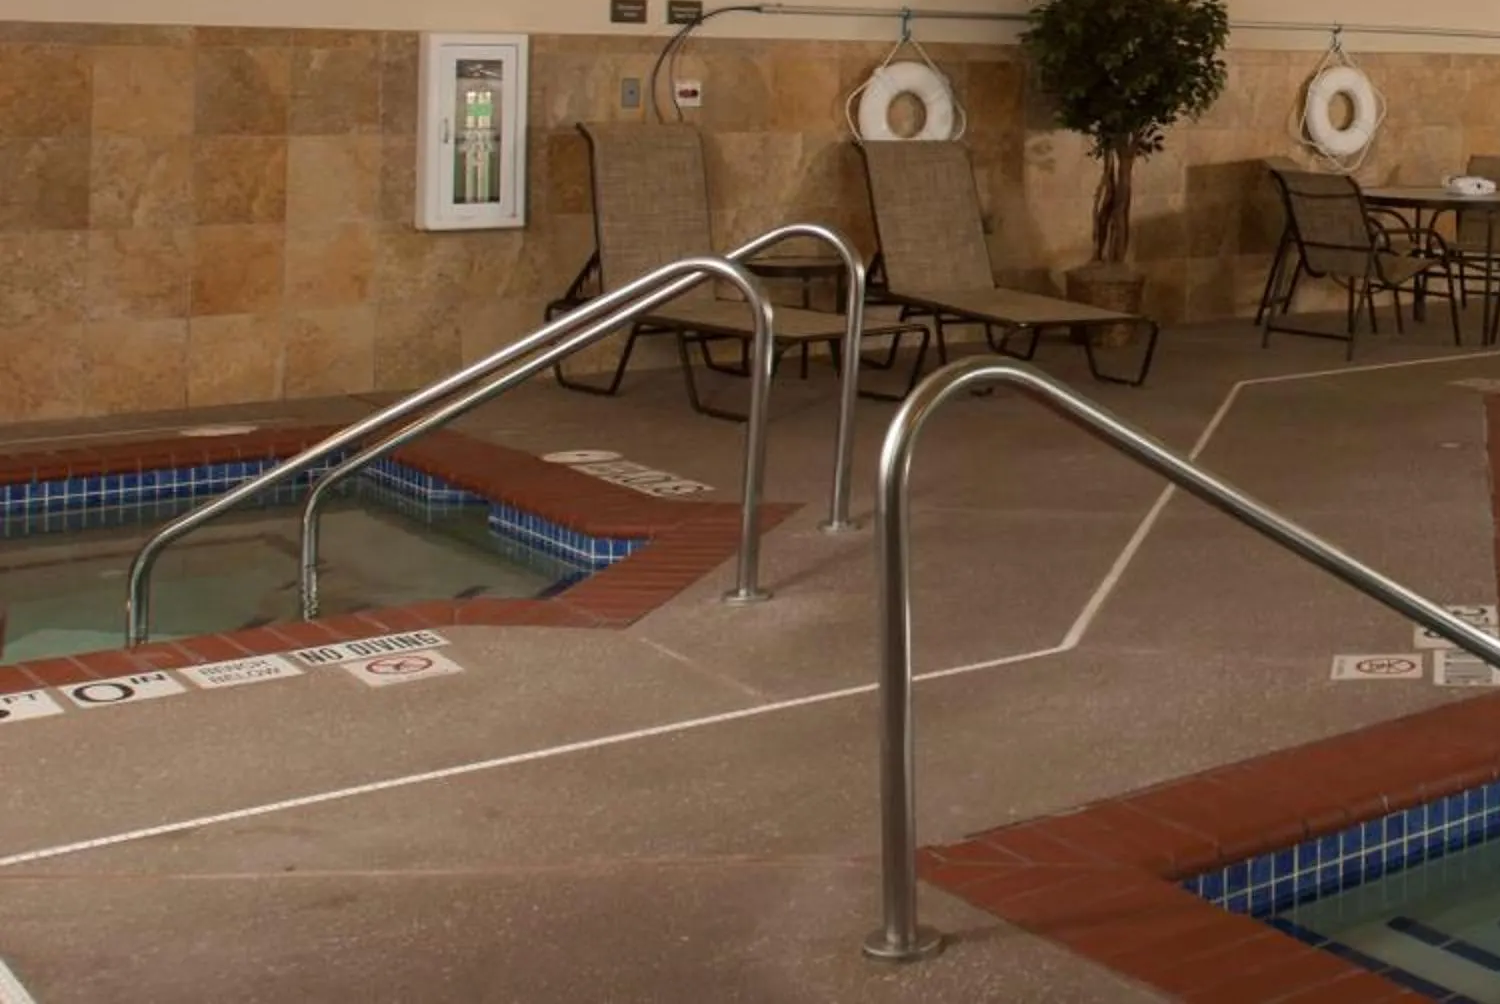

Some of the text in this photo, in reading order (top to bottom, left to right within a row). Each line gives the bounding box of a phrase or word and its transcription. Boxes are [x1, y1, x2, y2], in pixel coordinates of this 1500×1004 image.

[300, 633, 441, 663] NO DIVING
[130, 673, 166, 685] IN
